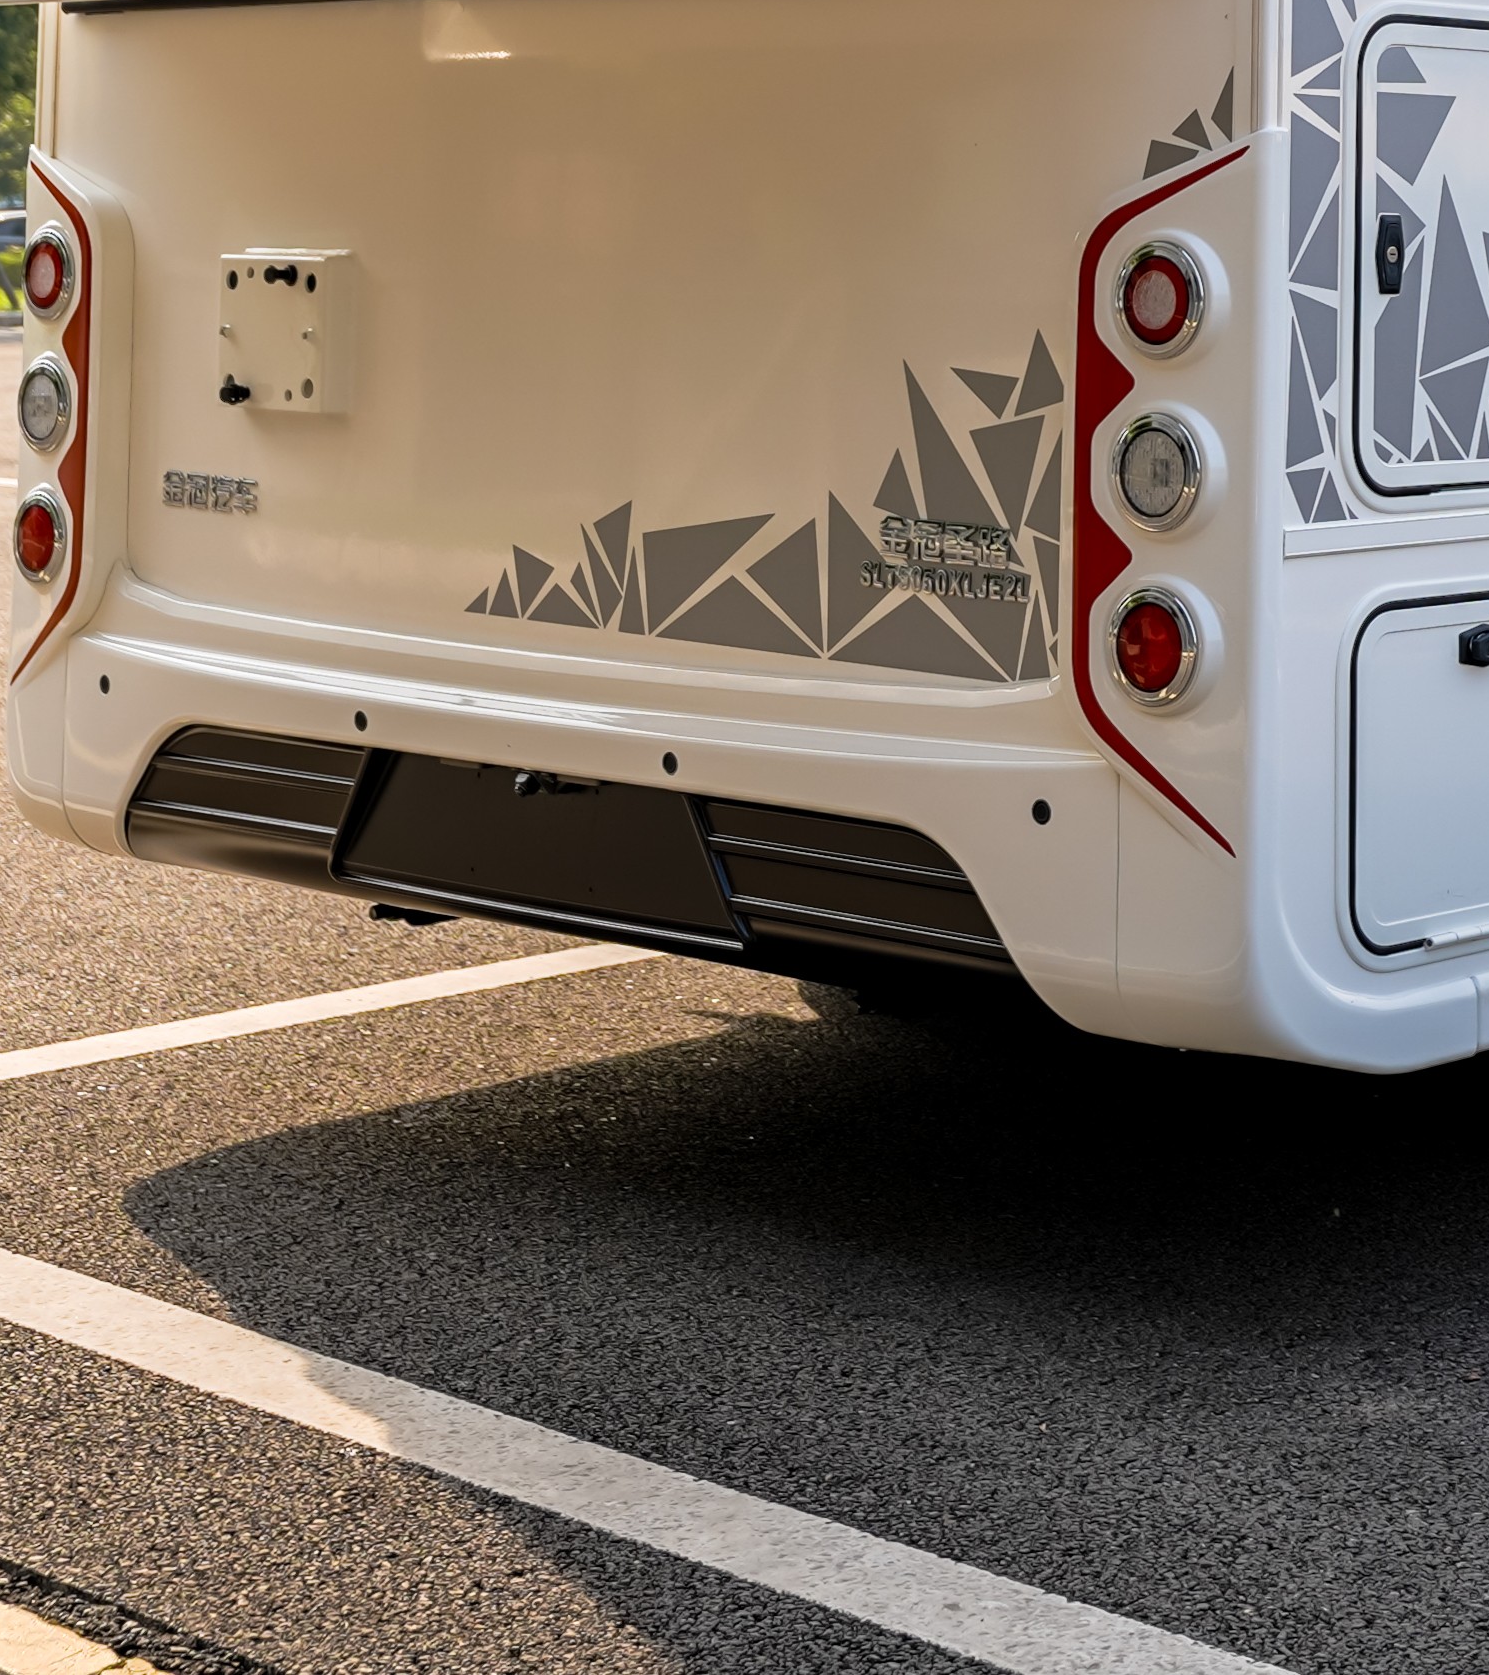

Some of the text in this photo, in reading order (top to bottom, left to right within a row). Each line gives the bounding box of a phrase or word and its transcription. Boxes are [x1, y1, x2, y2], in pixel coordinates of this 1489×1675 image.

[162, 469, 259, 516] 金冠汽车
[878, 514, 1011, 570] 金冠圣路
